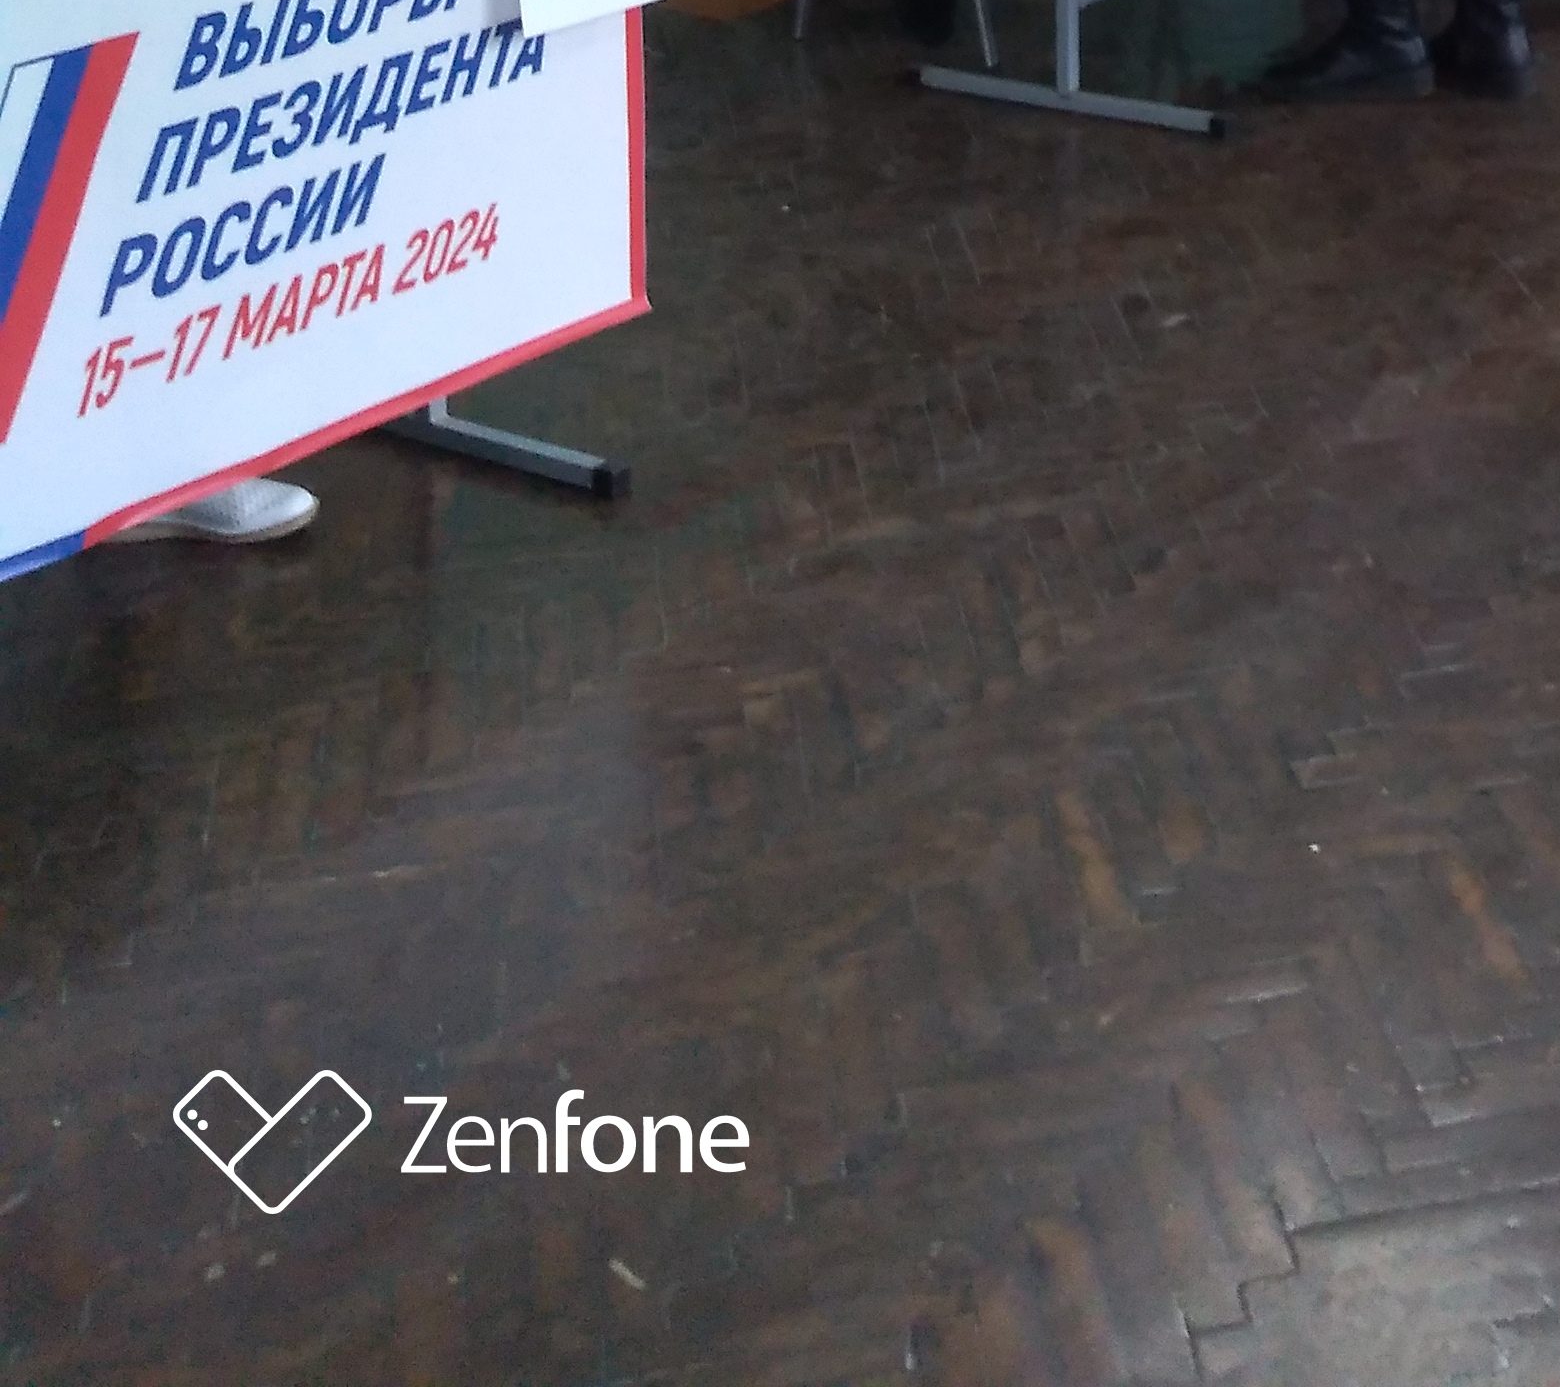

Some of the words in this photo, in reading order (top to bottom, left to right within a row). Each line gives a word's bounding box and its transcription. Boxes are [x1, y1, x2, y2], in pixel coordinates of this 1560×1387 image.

[135, 17, 546, 204] ПРЕЗИДЕНТА
[99, 153, 386, 318] РОССИИ
[221, 244, 386, 361] МАРТА
[391, 202, 499, 296] 2024
